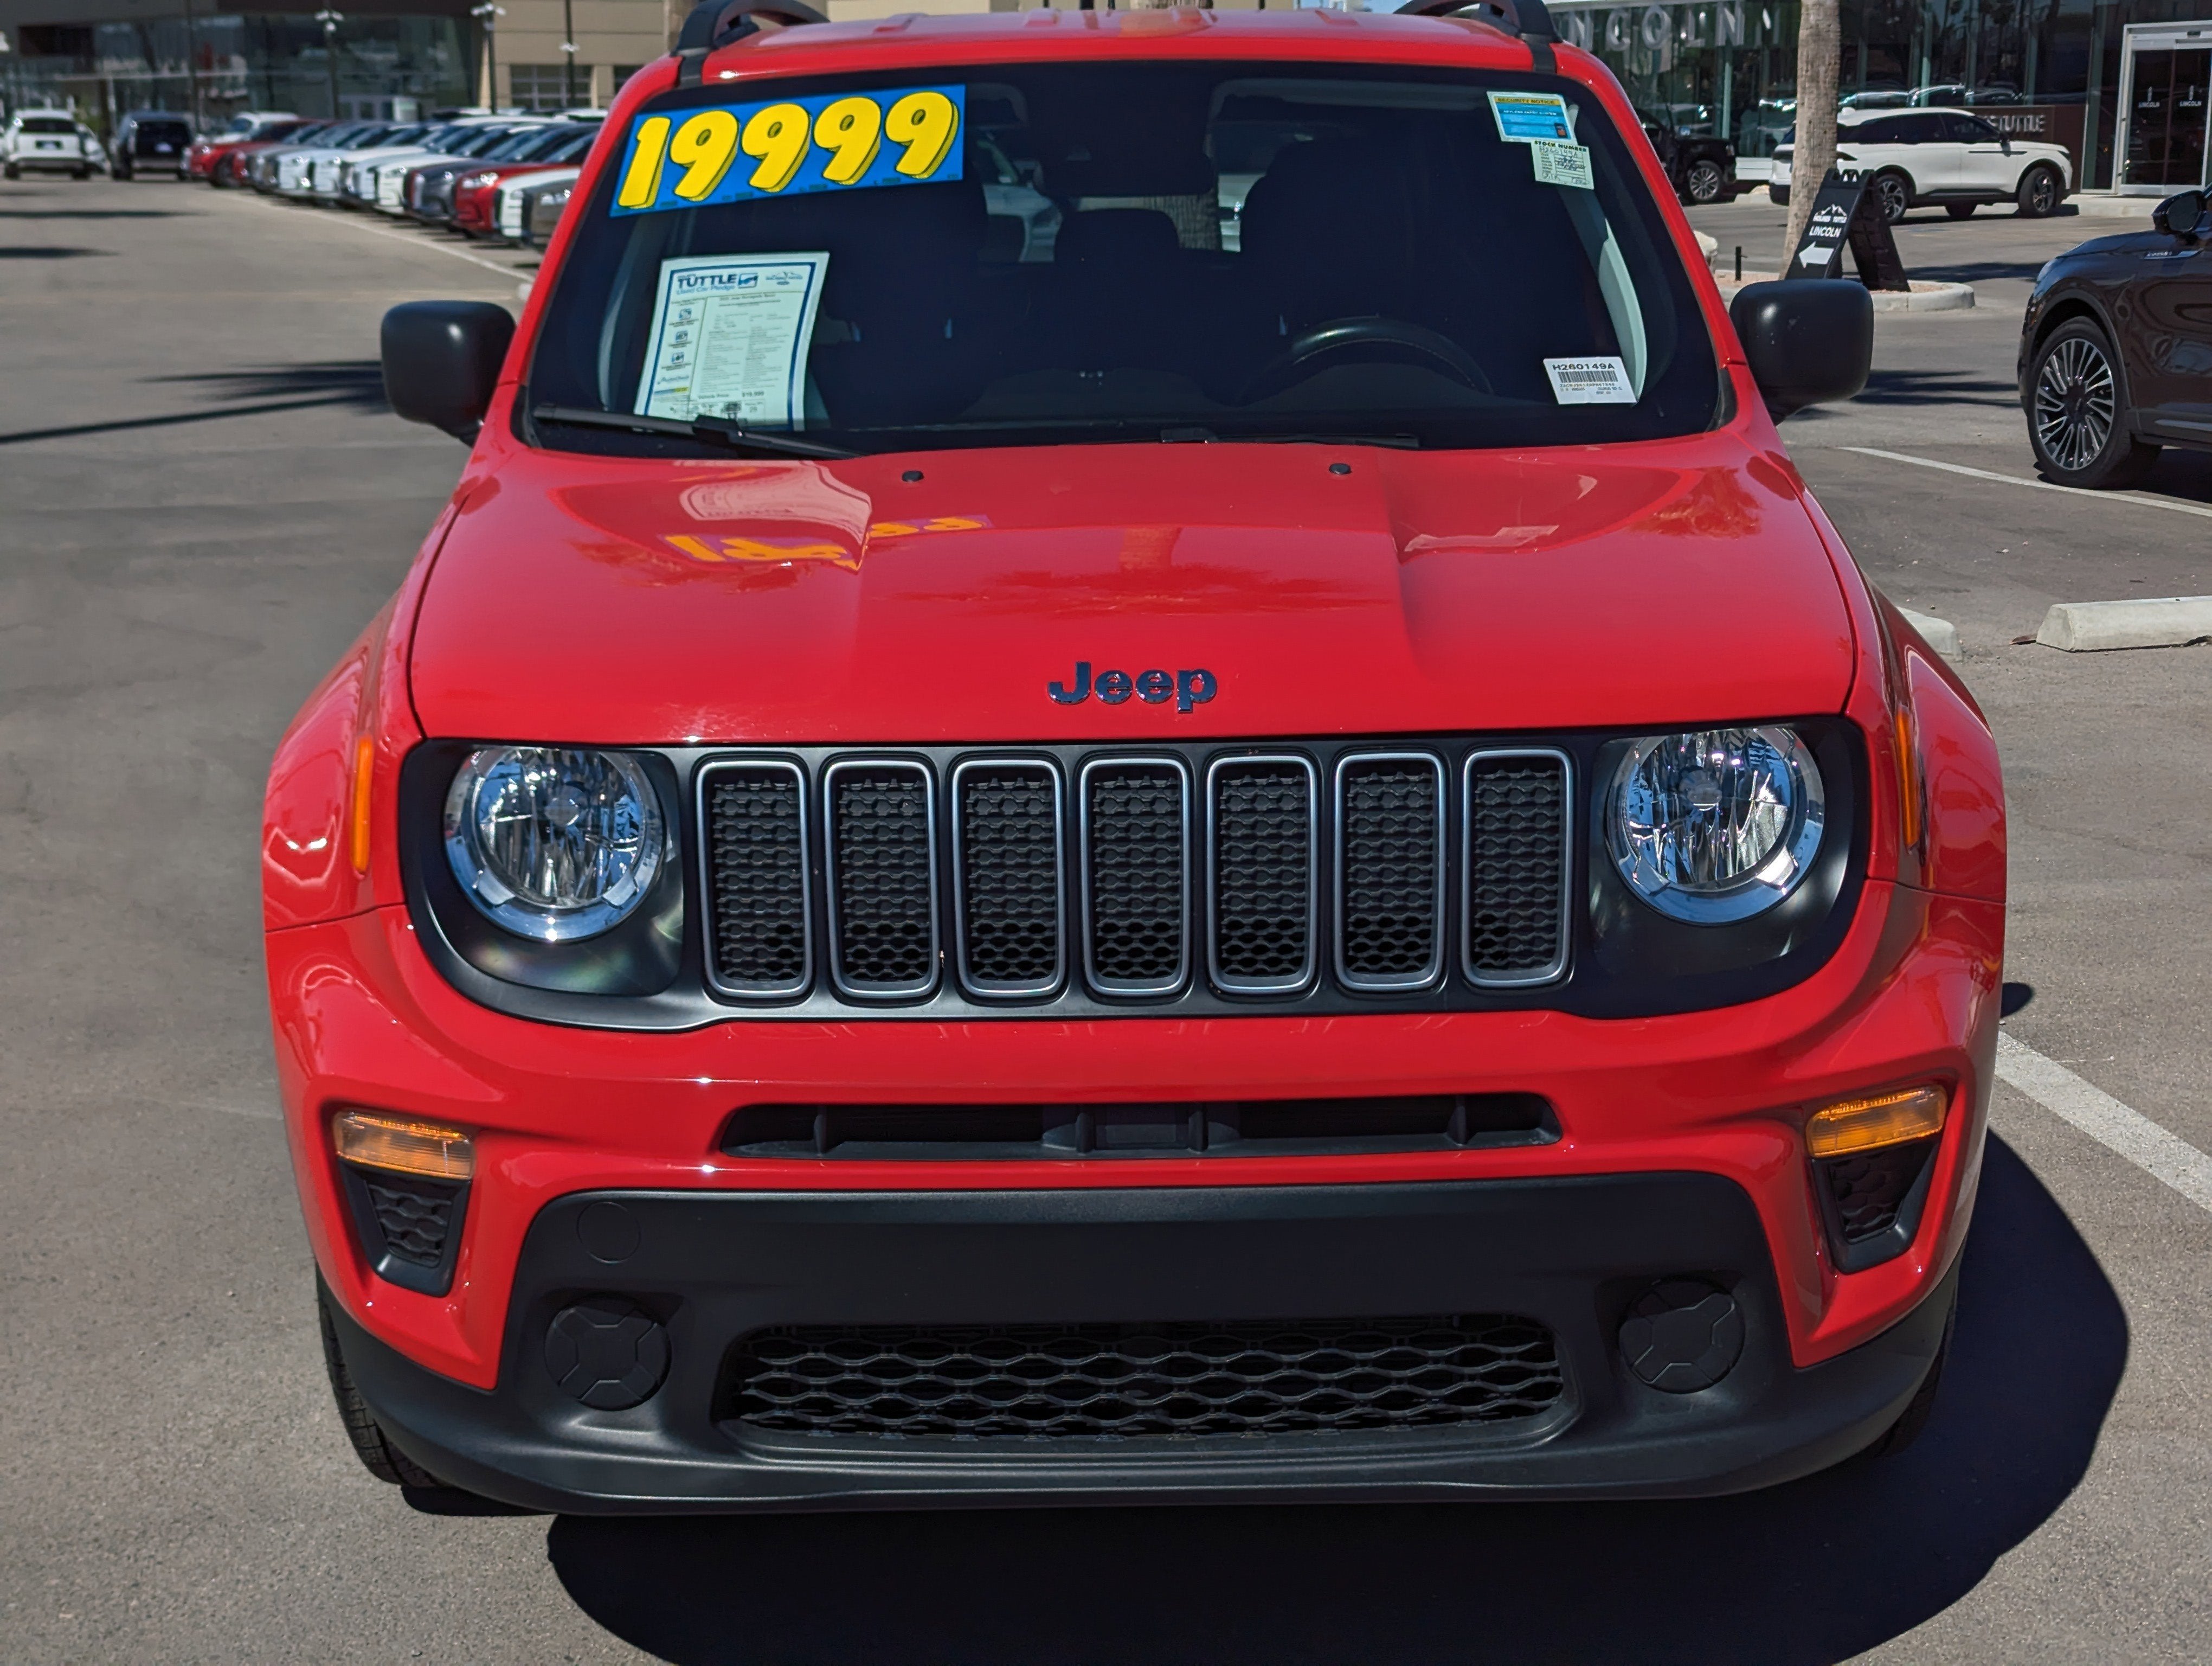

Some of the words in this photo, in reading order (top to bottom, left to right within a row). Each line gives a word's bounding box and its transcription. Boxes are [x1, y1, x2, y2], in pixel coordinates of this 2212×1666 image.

[1568, 2, 1745, 51] NCOLN
[617, 91, 960, 209] 19999
[1558, 144, 1587, 152] NUMBER
[1809, 226, 1842, 238] LINCOLN
[678, 273, 737, 289] TUTTLE
[1047, 661, 1218, 714] Jeep
